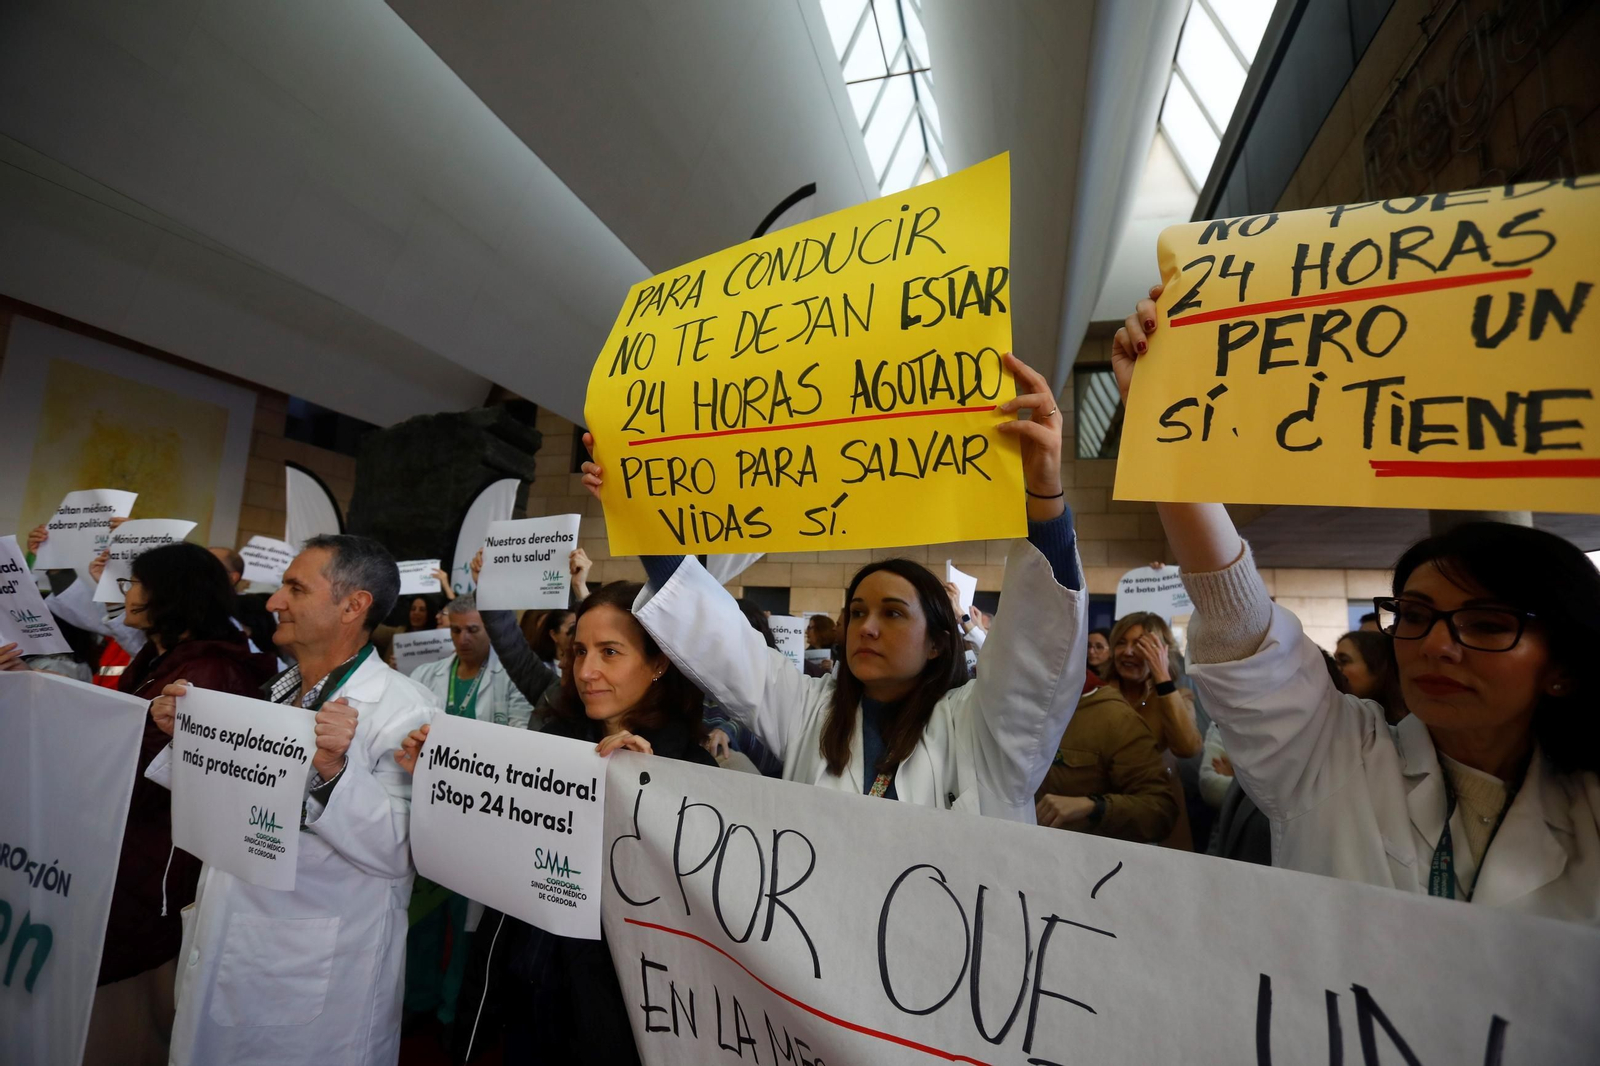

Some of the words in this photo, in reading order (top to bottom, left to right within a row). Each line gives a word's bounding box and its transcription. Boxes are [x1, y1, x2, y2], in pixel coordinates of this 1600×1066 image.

[626, 270, 705, 326] PARA
[724, 204, 946, 297] CONDUCIR
[1167, 254, 1255, 319] 24
[1291, 209, 1556, 297] HORAS
[609, 332, 656, 377] NO
[673, 316, 717, 366] TE
[730, 283, 875, 359] DEJAN
[901, 265, 1009, 330] ESTAR
[1216, 305, 1407, 377] PERO
[1471, 282, 1595, 349] UN
[621, 379, 665, 435] 24
[693, 362, 822, 431] HORAS
[851, 346, 1002, 415] AGOTADO
[1157, 383, 1238, 443] SÍ.
[620, 456, 716, 499] PERO
[736, 444, 818, 489] PARA
[841, 430, 992, 484] SALVAR
[49, 520, 78, 530] sobran
[528, 530, 574, 544] derechos
[658, 504, 773, 545] VIDAS
[799, 492, 847, 537] SÍ.
[493, 556, 510, 564] son
[512, 553, 522, 563] tu
[524, 549, 556, 562] salud”
[542, 570, 564, 581] SMA
[177, 712, 217, 740] “Menos
[219, 728, 308, 765] explotación,
[183, 748, 204, 768] más
[205, 757, 287, 788] protección”
[429, 745, 500, 784] ¡Mónica,
[506, 764, 597, 802] traidora!
[249, 805, 283, 833] SMA
[430, 780, 475, 814] ¡Stop
[479, 791, 504, 817] 24
[508, 797, 573, 835] horas!
[244, 836, 266, 848] SINDICATO
[267, 842, 286, 853] MÉDICO
[534, 848, 582, 878] SMA
[530, 880, 562, 895] SINDICATO
[563, 888, 587, 901] MÉDICO
[538, 892, 546, 900] DE
[546, 894, 577, 908] CÓRDOBA
[610, 771, 821, 979] ¿POR
[640, 952, 697, 1038] EN
[713, 985, 759, 1064] LA
